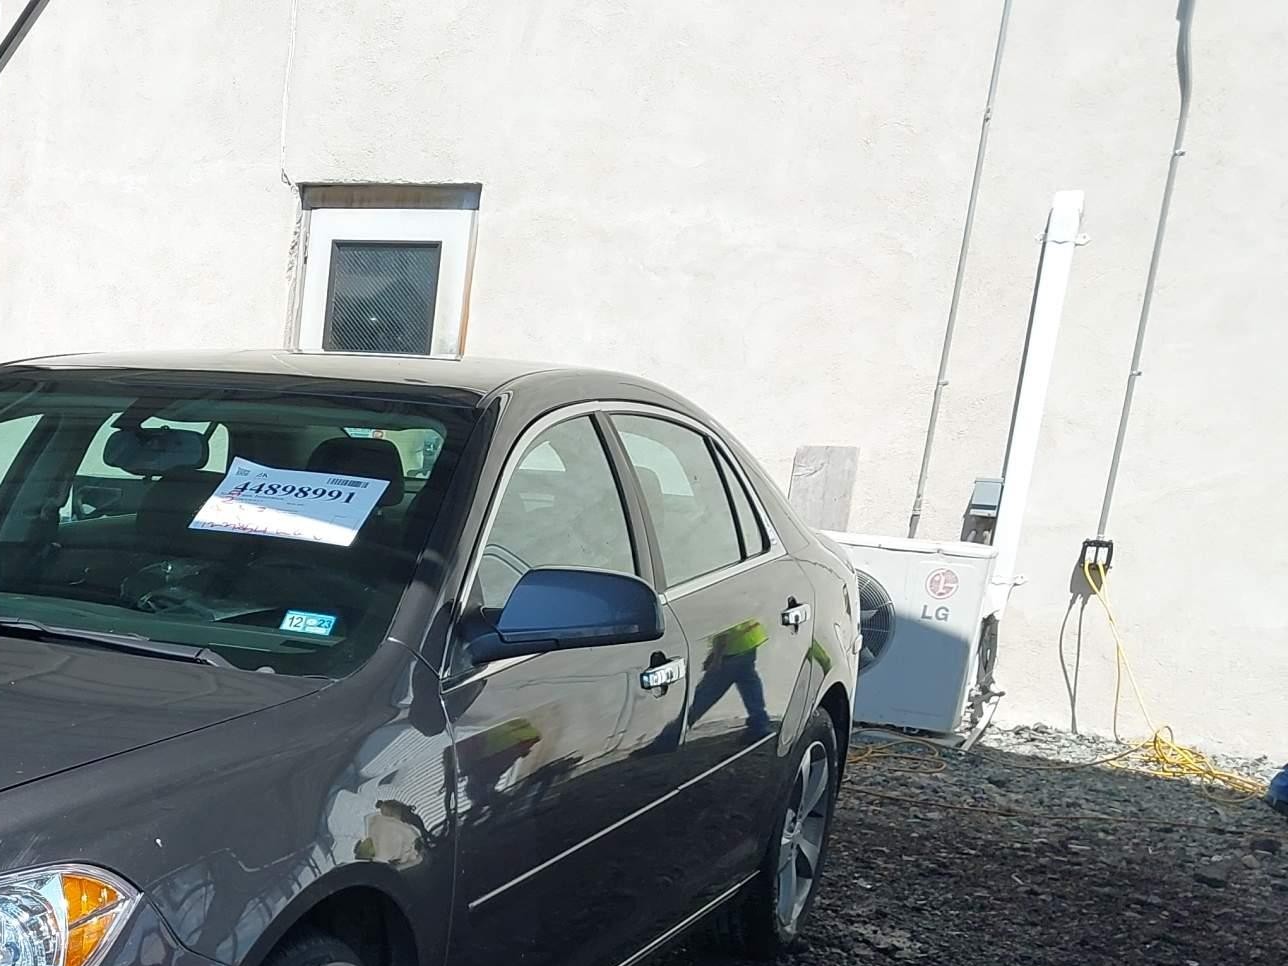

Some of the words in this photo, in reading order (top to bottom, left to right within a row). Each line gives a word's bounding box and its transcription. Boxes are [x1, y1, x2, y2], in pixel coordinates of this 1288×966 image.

[232, 481, 356, 504] 44898991
[921, 604, 950, 622] LG
[288, 616, 304, 627] 12
[316, 619, 333, 629] 23
